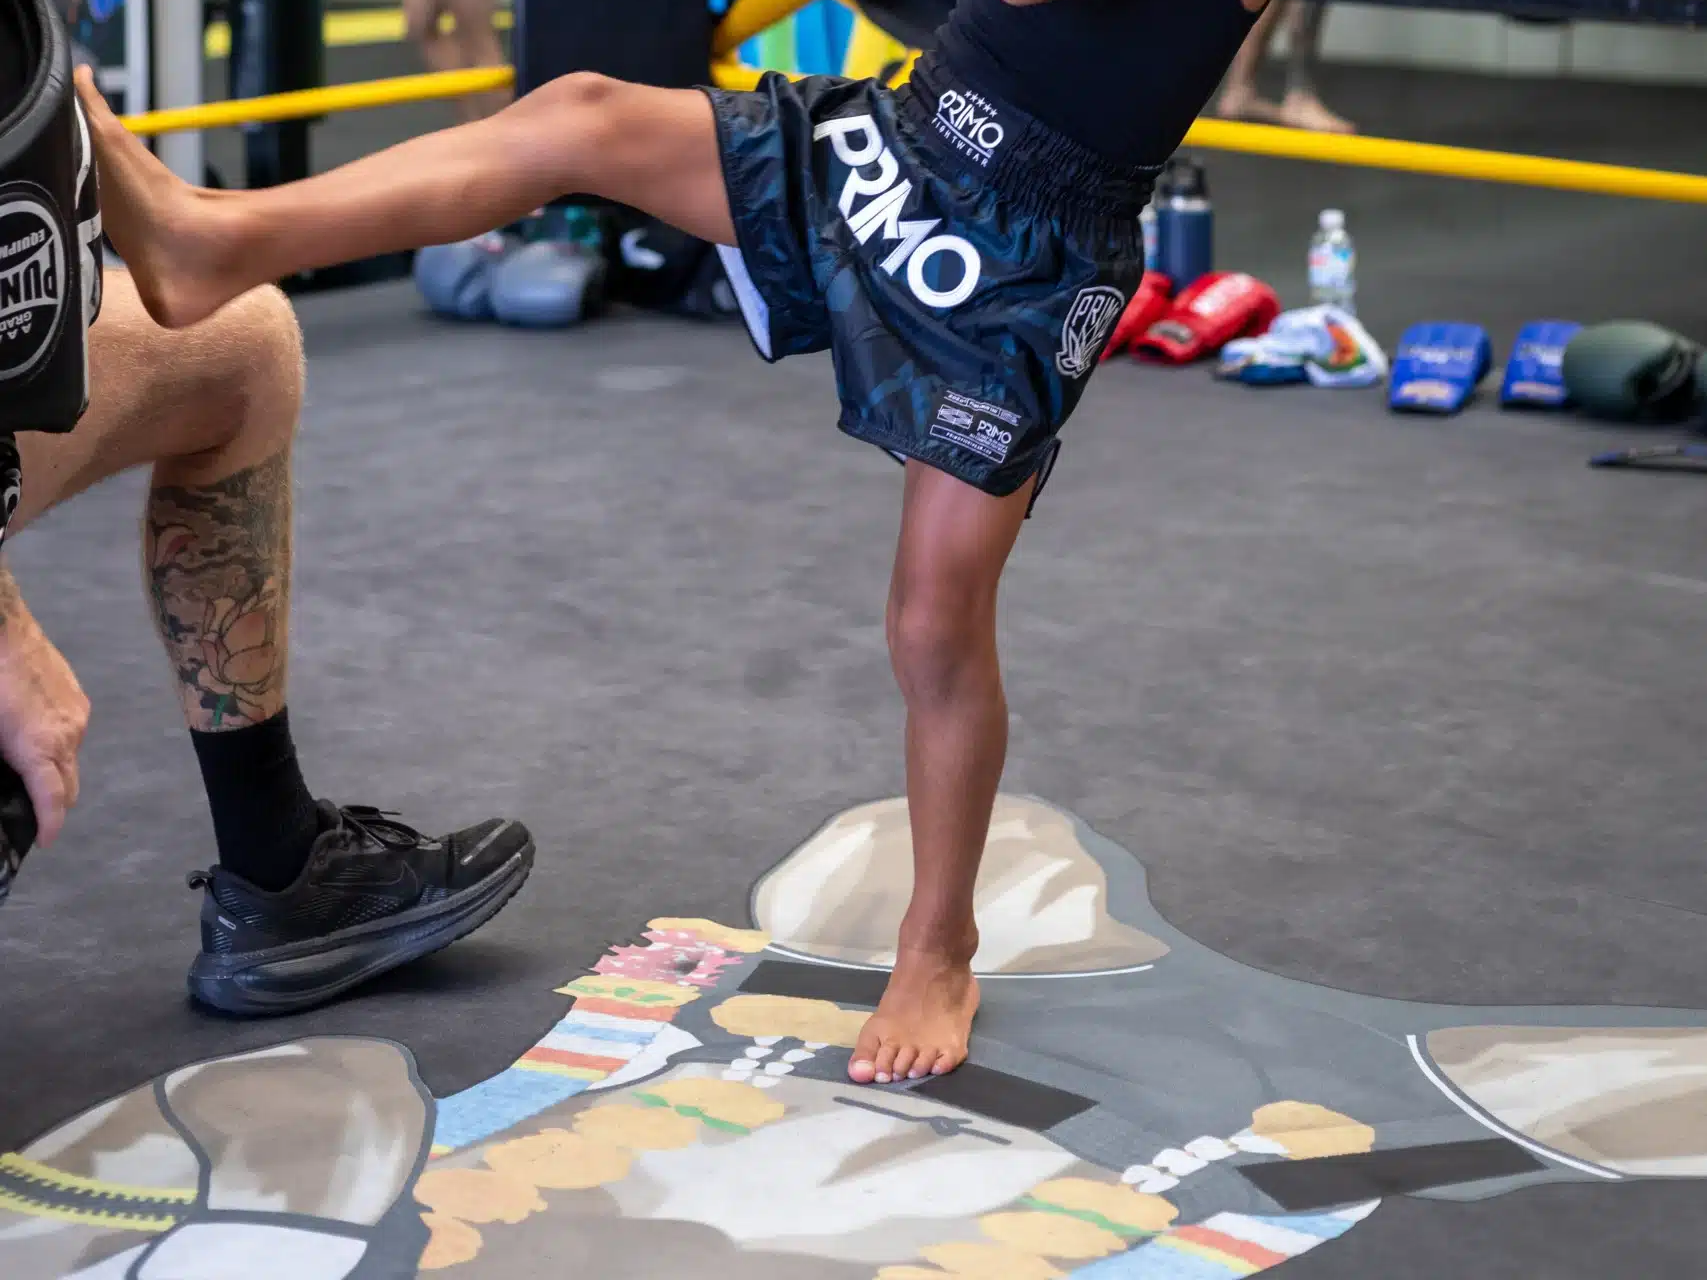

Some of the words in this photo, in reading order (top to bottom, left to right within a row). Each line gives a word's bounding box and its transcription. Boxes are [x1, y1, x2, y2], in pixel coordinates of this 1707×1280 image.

[938, 89, 1004, 149] PRIMO
[813, 114, 981, 308] PRIMO
[977, 420, 1012, 444] PRIMO
